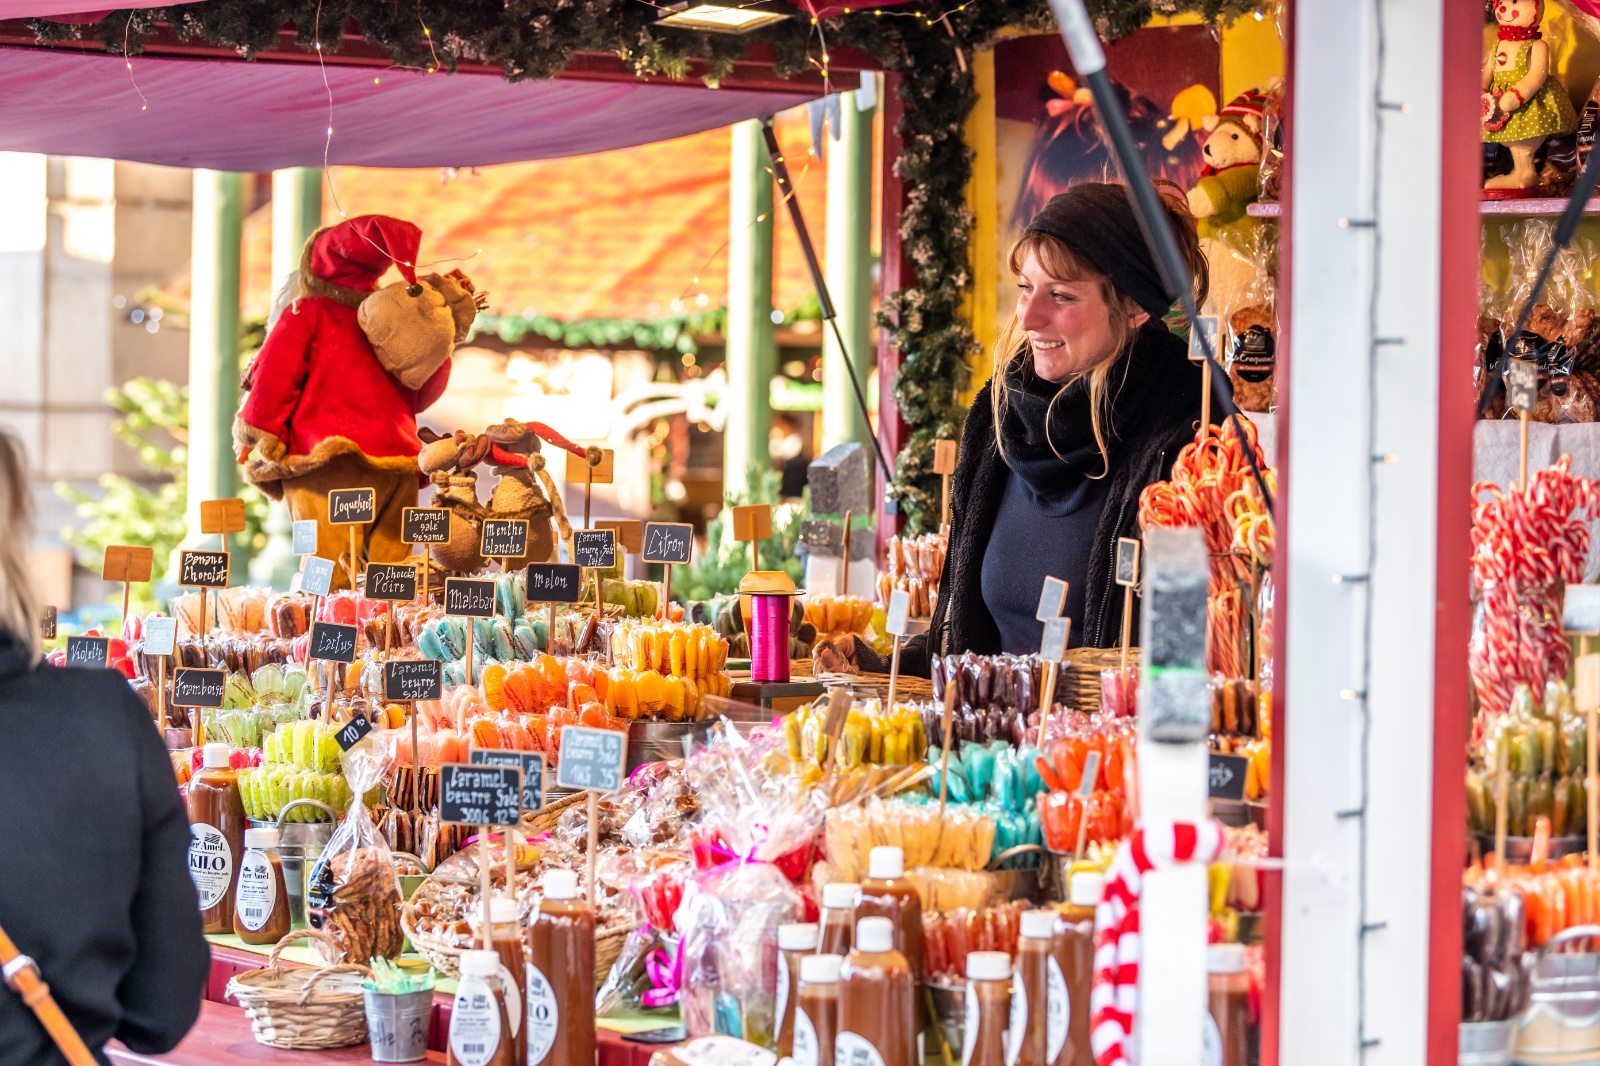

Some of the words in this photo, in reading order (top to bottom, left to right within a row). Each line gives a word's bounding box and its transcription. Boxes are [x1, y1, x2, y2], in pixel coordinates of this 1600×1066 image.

[334, 493, 373, 519] Coquelicot
[409, 509, 446, 522] Caramel
[420, 521, 440, 531] salé
[486, 519, 523, 537] Menthe
[485, 537, 523, 554] blanche
[578, 530, 608, 544] Caramel
[647, 529, 685, 559] Citron
[577, 543, 599, 555] beurre
[184, 552, 224, 566] Banane
[183, 565, 228, 583] Chocolat
[373, 571, 405, 593] Poire
[448, 587, 494, 610] Malabar
[70, 640, 104, 662] Violette
[318, 631, 353, 654] Cactus
[391, 660, 438, 678] Caramel
[175, 669, 224, 697] Framboise
[401, 675, 435, 688] beurre
[403, 687, 431, 699] salé
[343, 725, 360, 743] 10
[450, 766, 508, 788] Caramel
[445, 781, 491, 805] beurre
[493, 808, 510, 825] 12
[190, 853, 226, 871] KILO
